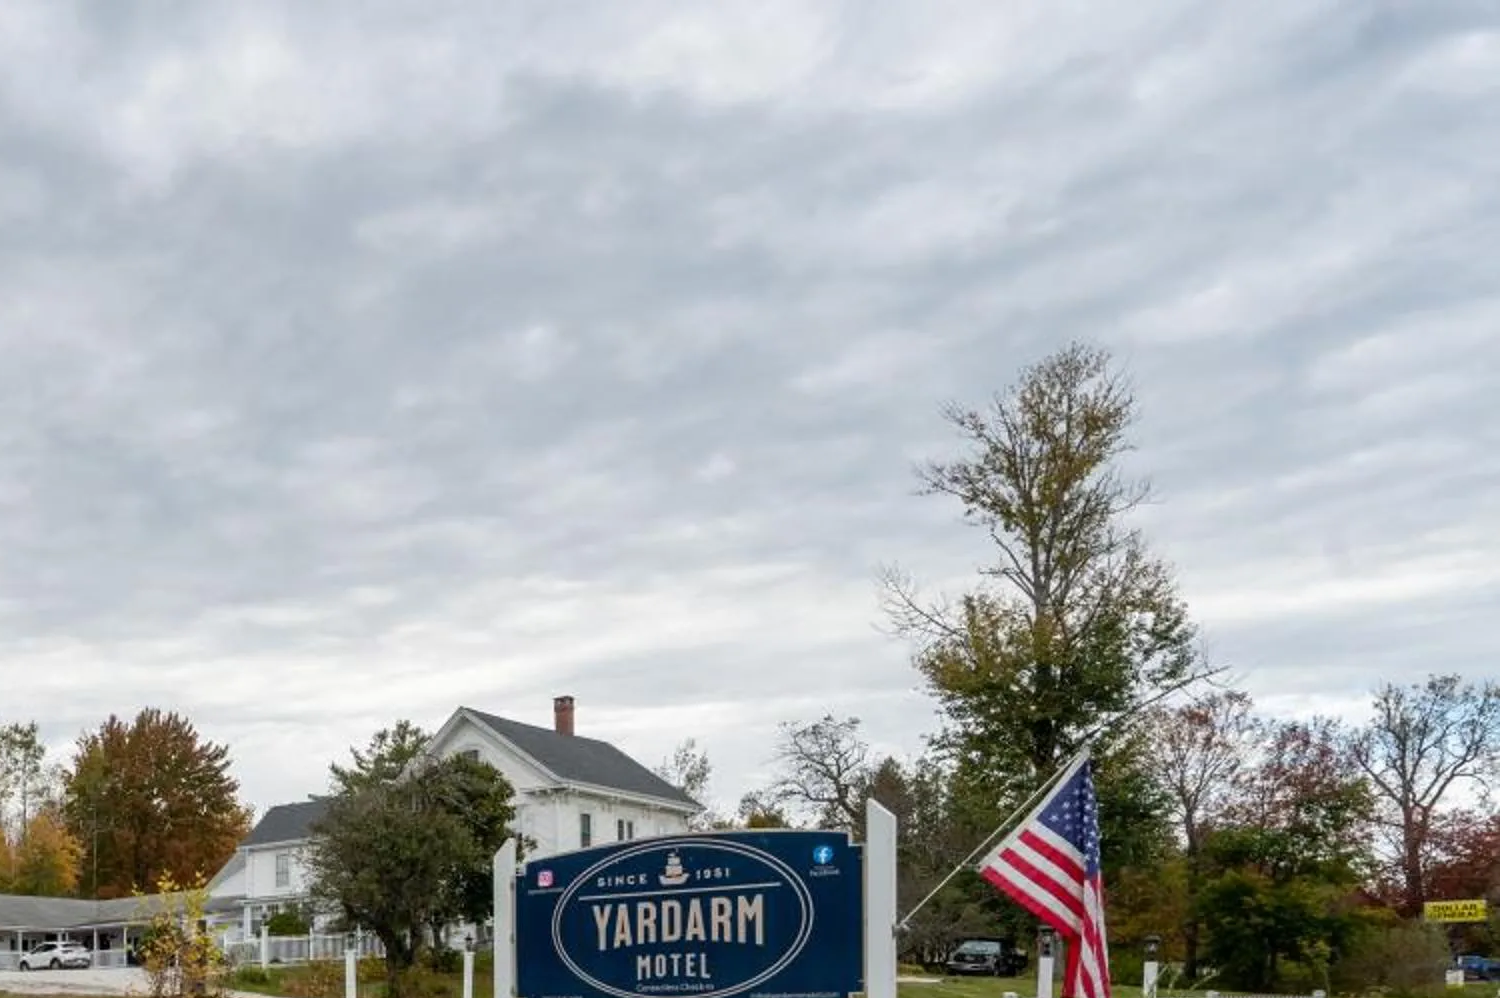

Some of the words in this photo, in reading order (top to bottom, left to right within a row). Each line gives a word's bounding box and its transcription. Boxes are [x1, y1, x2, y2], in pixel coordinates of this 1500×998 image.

[597, 873, 648, 887] SINCE
[592, 894, 764, 951] YARDARM
[636, 952, 712, 981] MOTEL
